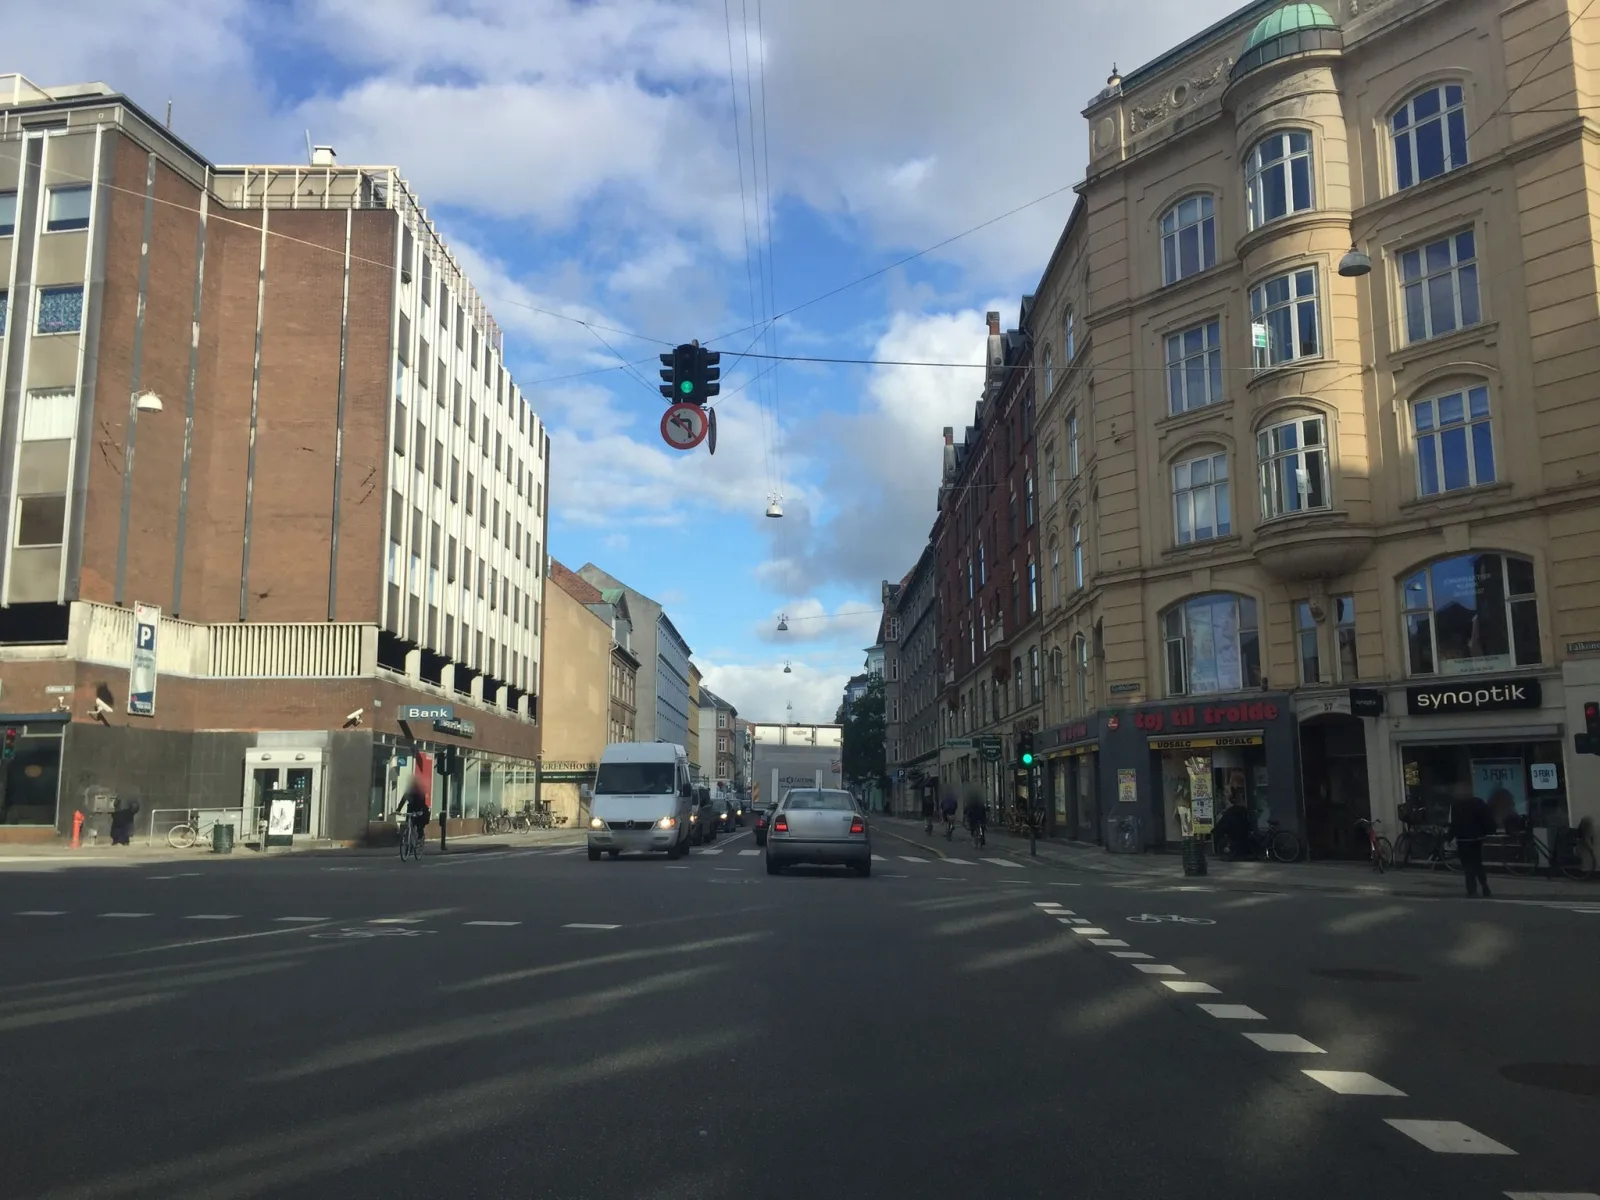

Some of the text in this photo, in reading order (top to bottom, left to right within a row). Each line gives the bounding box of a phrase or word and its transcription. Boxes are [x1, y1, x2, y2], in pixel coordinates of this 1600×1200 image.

[140, 626, 152, 646] P
[1417, 684, 1526, 709] synoptik
[1324, 703, 1333, 711] 57
[409, 708, 448, 718] Bank
[1172, 706, 1195, 726] til
[1203, 702, 1278, 724] trolde
[1157, 740, 1192, 749] UDSALG
[1215, 737, 1253, 746] UDSALG
[543, 762, 599, 771] GREENHOUSE
[1482, 768, 1488, 780] 3
[1510, 768, 1514, 780] 1
[1533, 770, 1538, 778] 3
